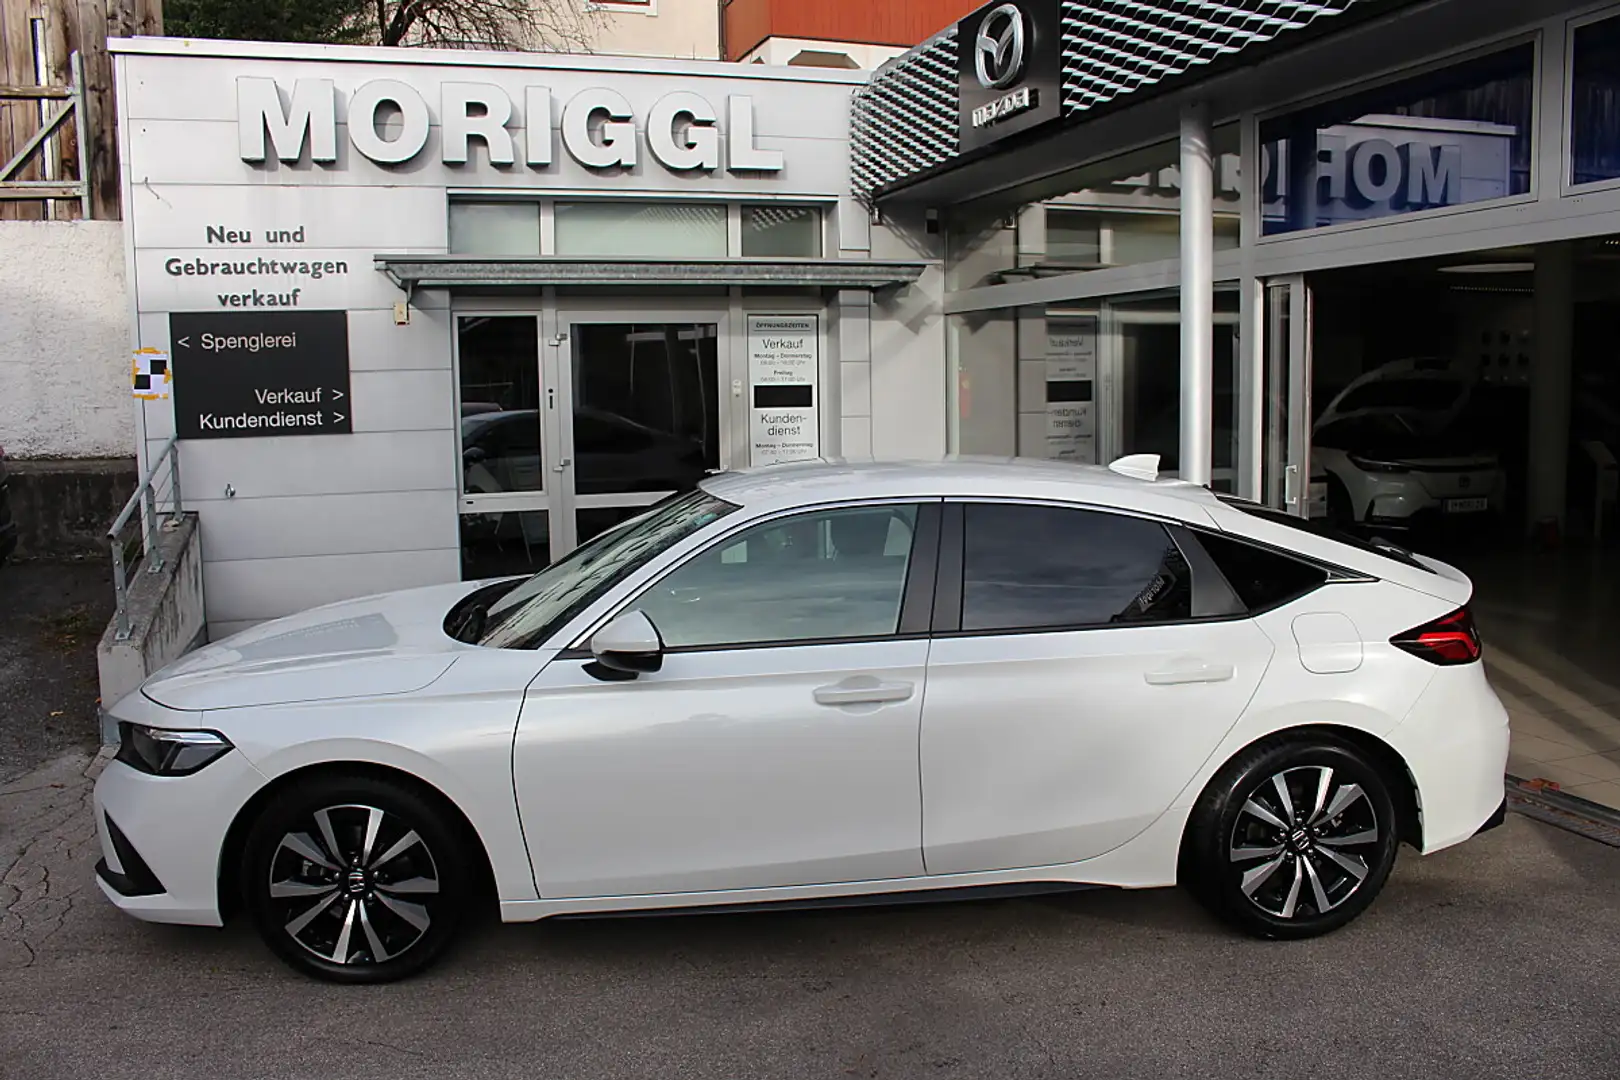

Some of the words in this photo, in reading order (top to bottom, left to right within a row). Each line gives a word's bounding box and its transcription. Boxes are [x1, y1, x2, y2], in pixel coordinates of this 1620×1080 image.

[236, 76, 783, 171] MORIGGL
[206, 225, 251, 244] Neu
[266, 225, 305, 243] und
[165, 257, 348, 279] Gebrauchtwagen
[218, 288, 301, 307] verkauf
[201, 332, 296, 353] Spenglerei
[762, 337, 804, 350] Verkauf
[255, 387, 322, 404] Verkauf
[199, 411, 323, 430] Kundendienst
[761, 413, 808, 424] Kunden-
[767, 425, 801, 437] dienst
